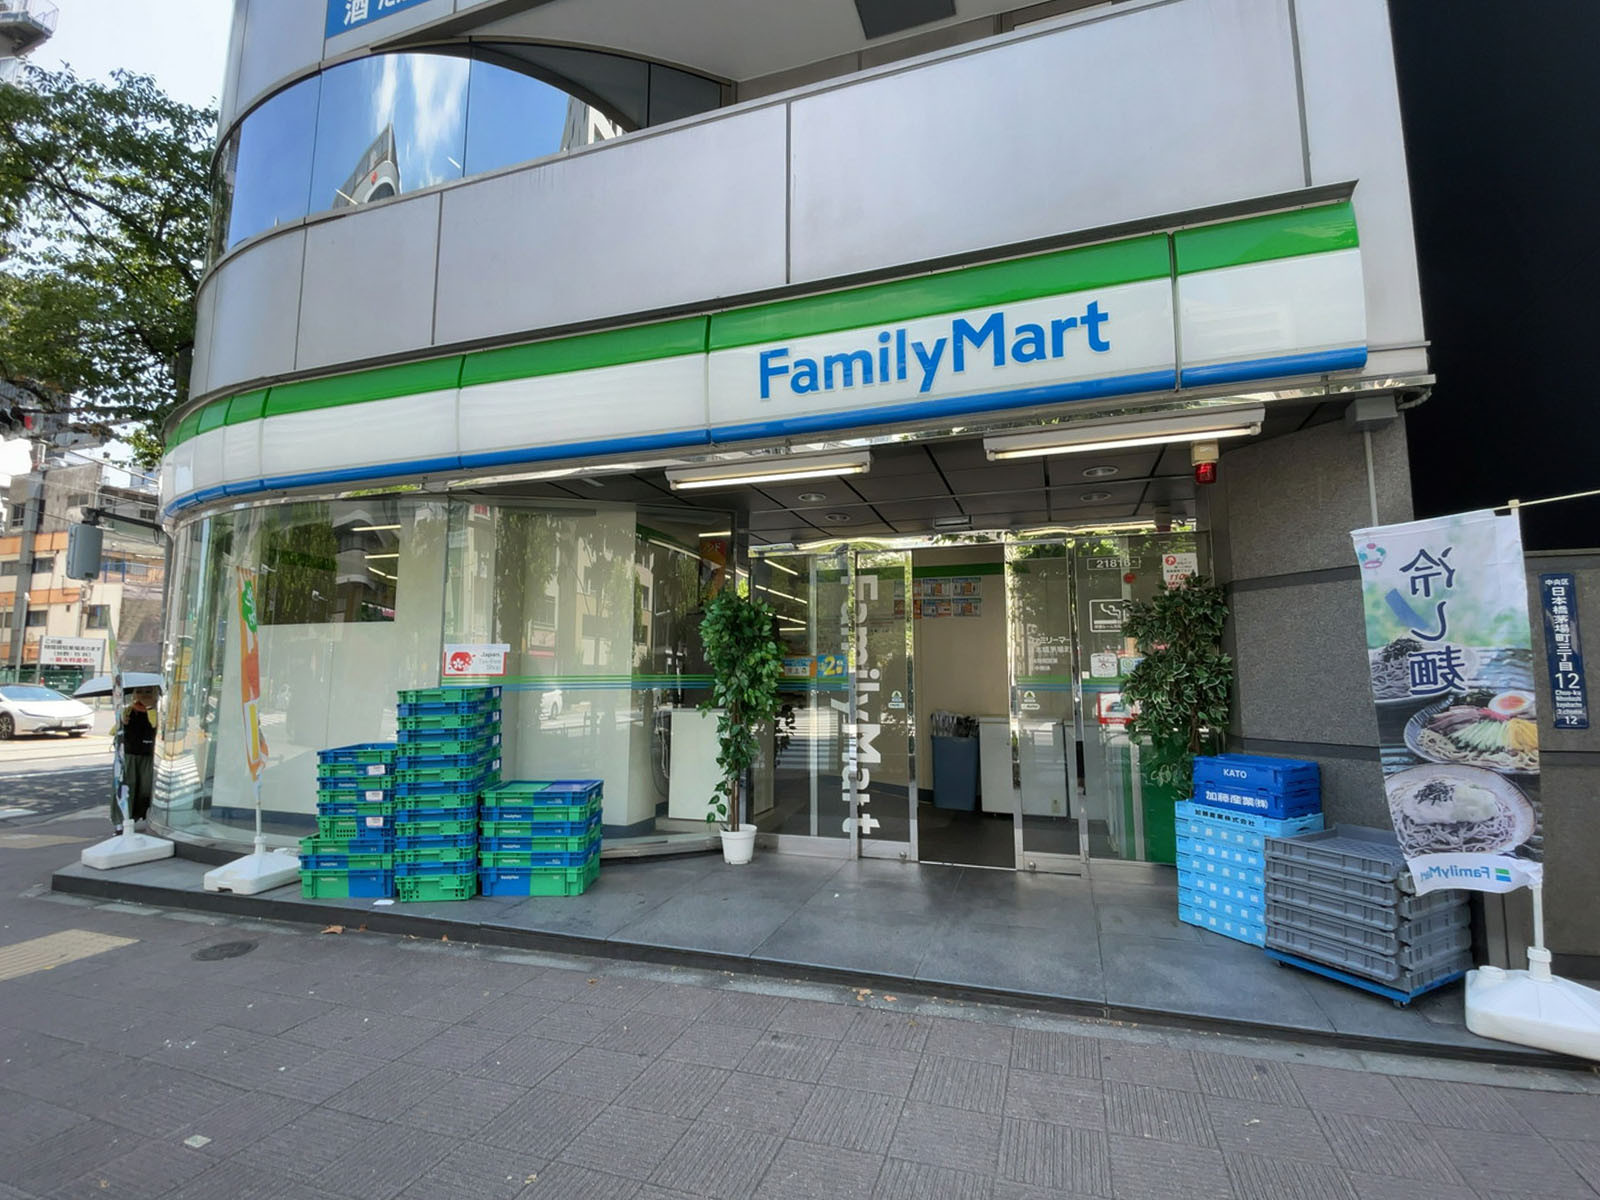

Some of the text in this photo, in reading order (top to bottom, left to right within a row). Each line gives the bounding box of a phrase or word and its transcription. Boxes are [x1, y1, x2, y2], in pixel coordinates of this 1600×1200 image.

[759, 300, 1111, 400] FamilyMart
[1555, 672, 1580, 689] 12
[1565, 715, 1578, 725] 12
[1223, 768, 1247, 779] KATO
